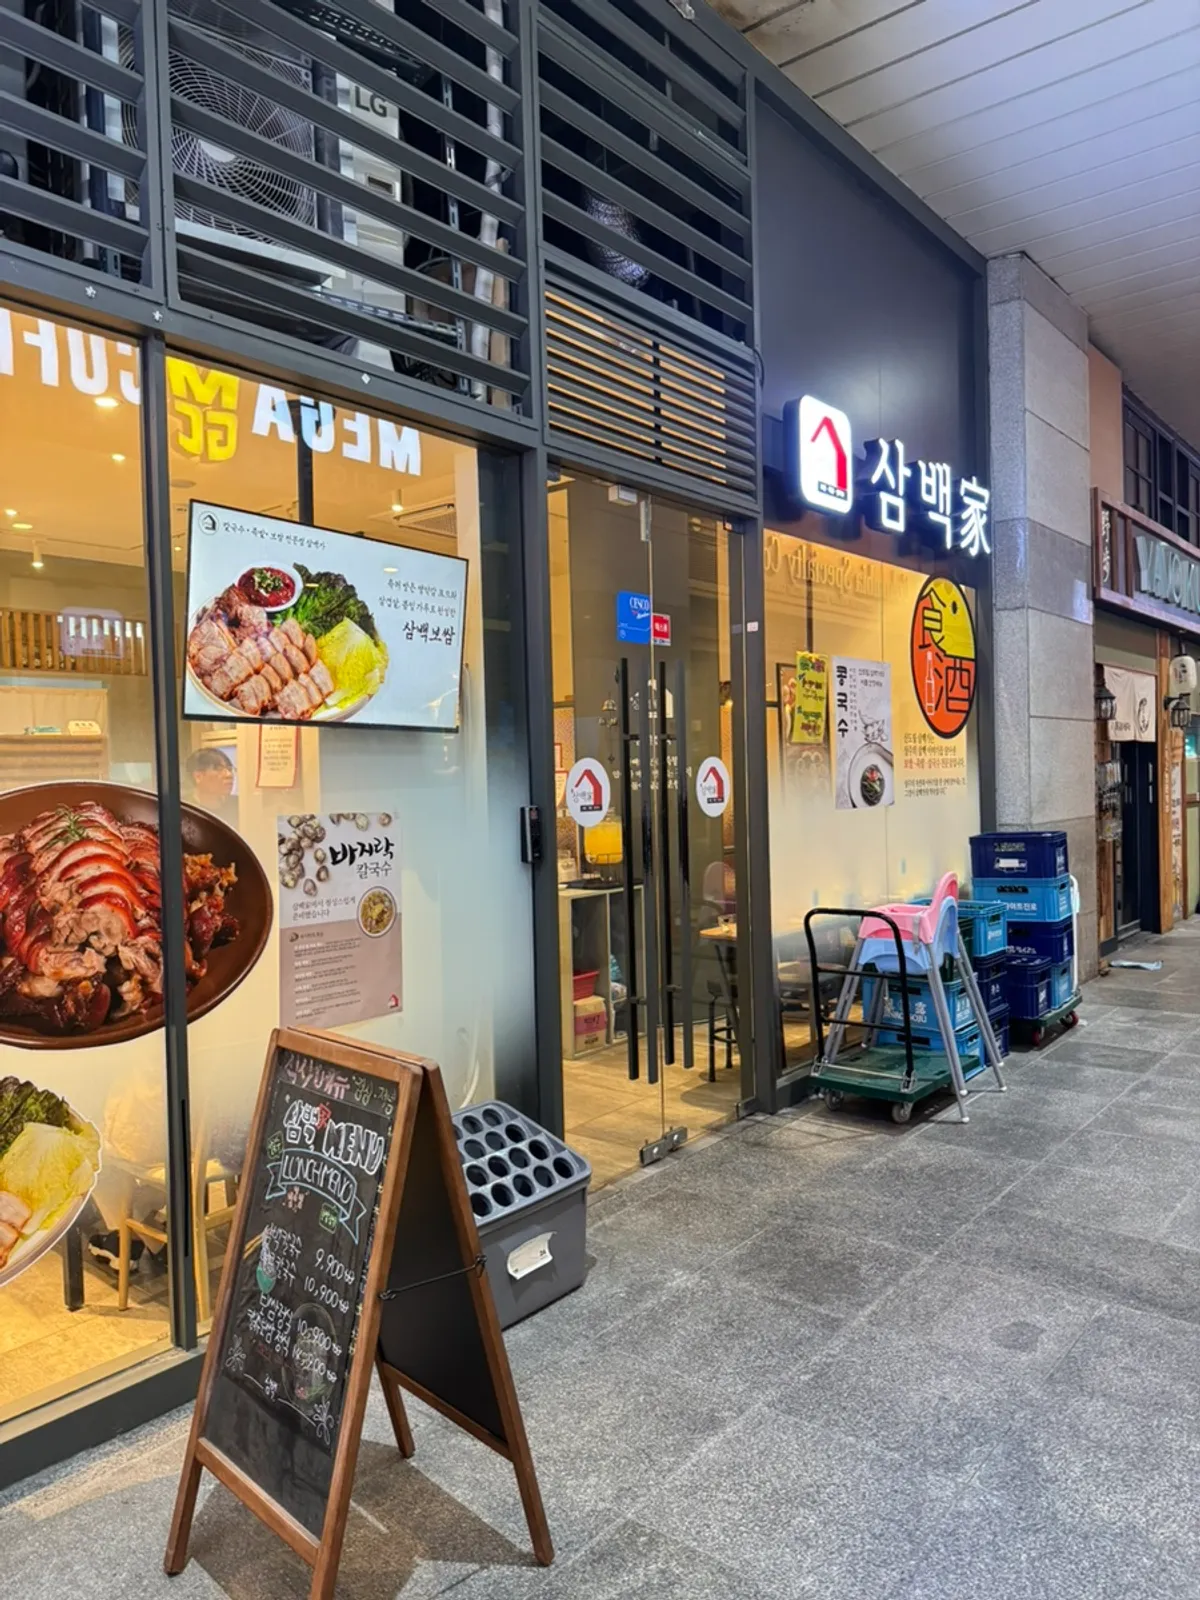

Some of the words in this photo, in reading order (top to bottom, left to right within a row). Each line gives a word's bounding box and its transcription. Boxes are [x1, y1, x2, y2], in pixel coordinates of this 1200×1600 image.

[354, 86, 388, 118] LG
[871, 438, 991, 556] 삼백家
[402, 619, 456, 646] 삼백보쌈
[328, 836, 395, 867] 바지락
[356, 860, 393, 880] 칼국수
[322, 1118, 386, 1176] MENU
